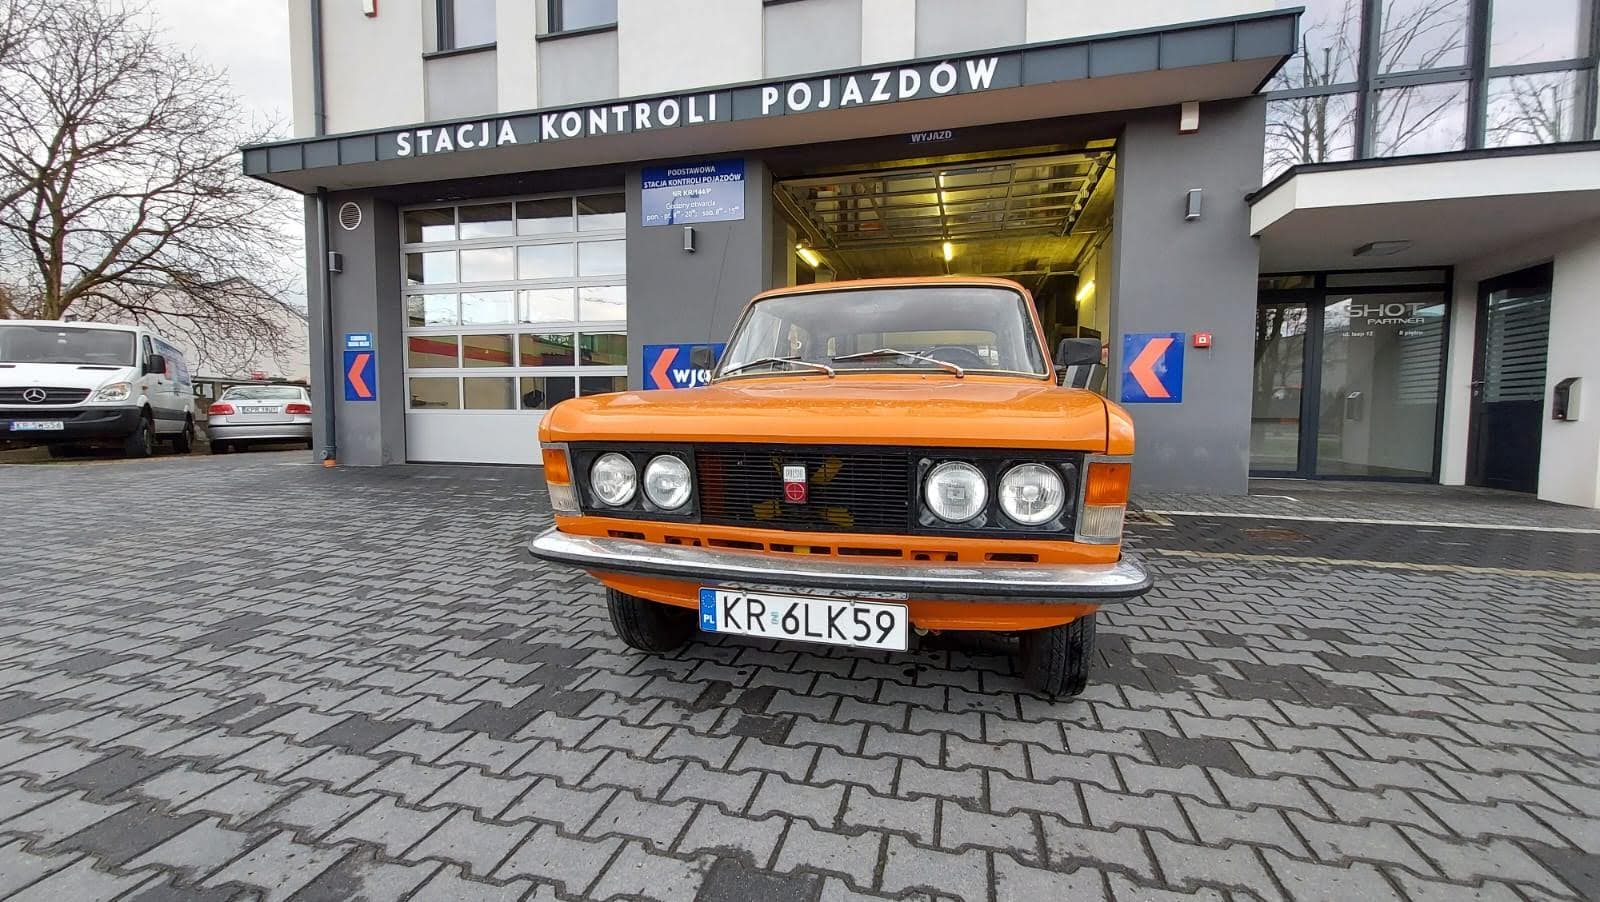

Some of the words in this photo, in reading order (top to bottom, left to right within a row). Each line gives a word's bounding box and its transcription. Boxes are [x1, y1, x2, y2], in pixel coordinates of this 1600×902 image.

[396, 120, 517, 157] STACJA
[541, 94, 716, 141] KONTROLI
[762, 57, 998, 115] POJAZDÓW
[911, 130, 952, 142] WYJAZD
[667, 165, 716, 177] PODSTAWOWA
[643, 180, 667, 189] STACJA
[668, 176, 701, 187] KONTROLI
[702, 173, 741, 183] POJAZDÓW
[672, 189, 682, 197] NR
[1344, 302, 1427, 318] SHOT
[1367, 317, 1425, 325] PARTNER
[703, 614, 715, 624] PL
[723, 596, 766, 632] KR
[781, 602, 895, 644] 6LK59
